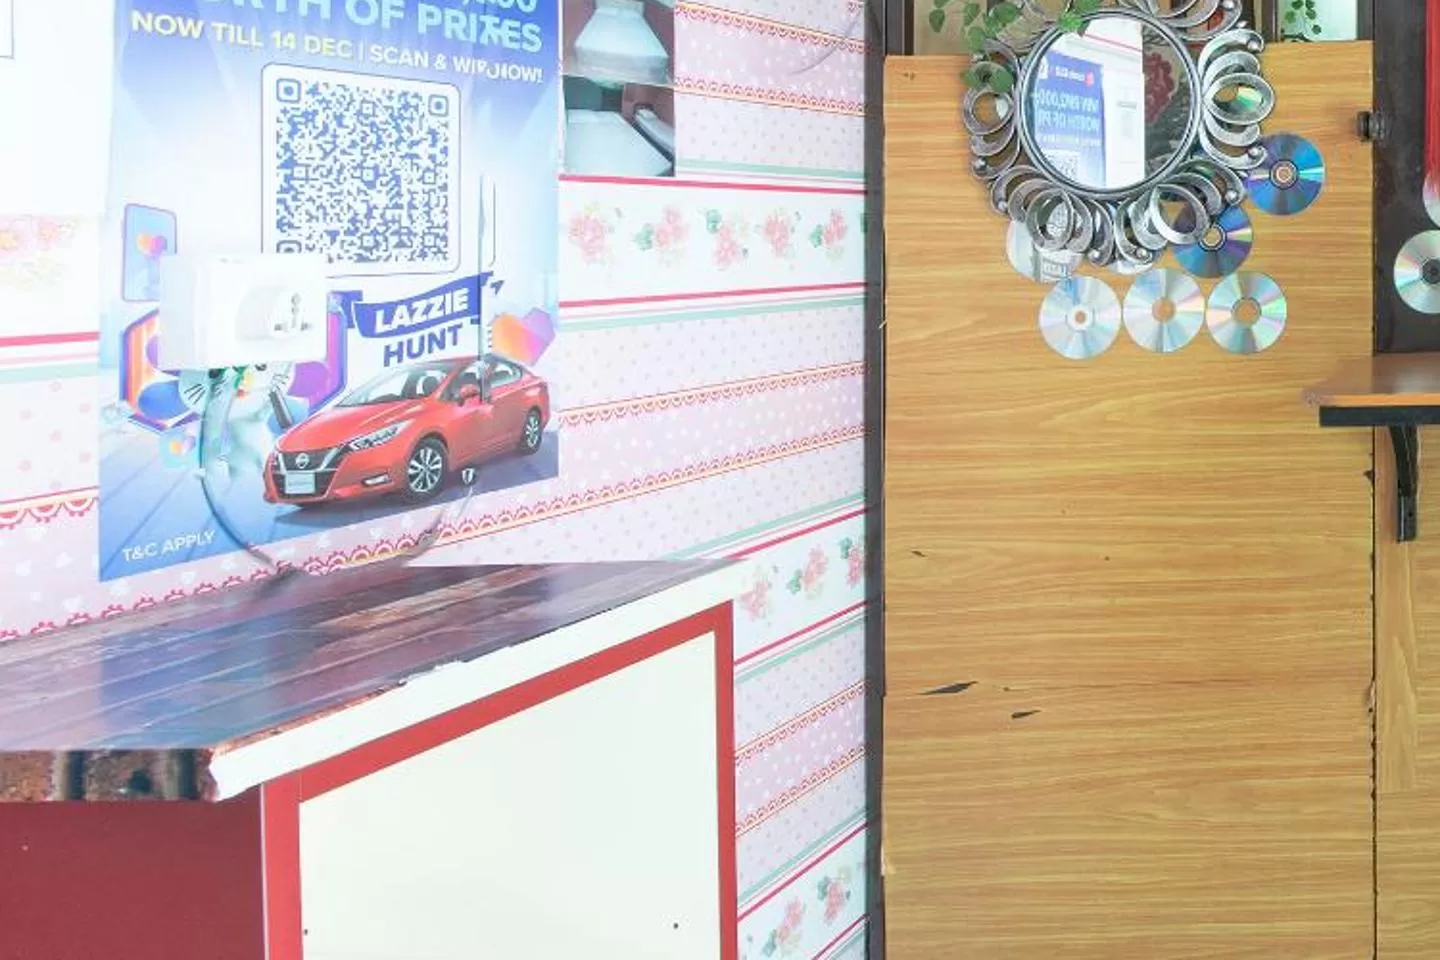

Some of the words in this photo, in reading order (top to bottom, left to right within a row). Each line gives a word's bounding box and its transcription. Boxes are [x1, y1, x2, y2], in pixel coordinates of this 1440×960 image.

[131, 10, 204, 39] NOW
[212, 22, 263, 46] TILL
[271, 31, 296, 50] 14
[304, 35, 353, 59] DEC
[370, 45, 428, 68] SCAN
[434, 52, 447, 70] &
[375, 288, 469, 333] LAZZIE
[383, 323, 463, 367] HUNT
[122, 543, 158, 561] T&C
[162, 530, 216, 554] APPLY
